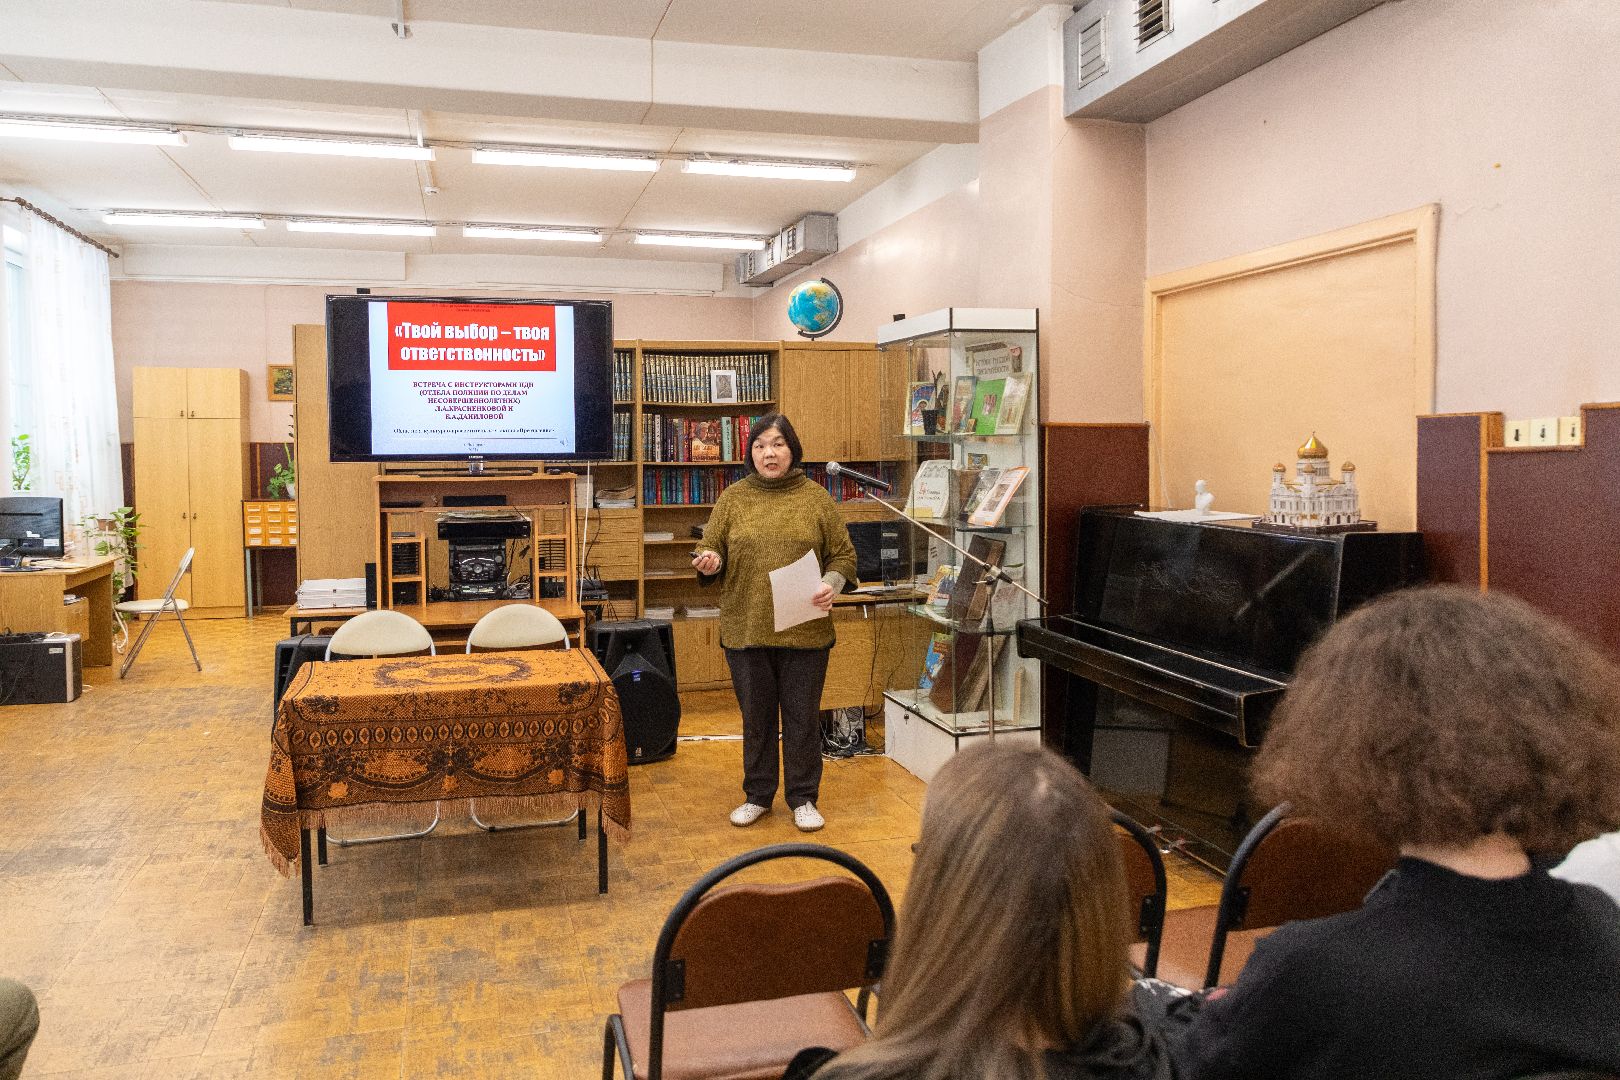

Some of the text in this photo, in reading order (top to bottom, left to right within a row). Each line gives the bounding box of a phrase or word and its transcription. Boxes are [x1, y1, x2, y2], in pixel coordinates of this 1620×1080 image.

[444, 323, 499, 341] выбор
[513, 326, 550, 341] твоя
[400, 346, 546, 362] ответственность»
[452, 389, 489, 397] ПОЛИЦИИ
[490, 389, 502, 397] ПО
[502, 389, 528, 397] ДЕЛАМ
